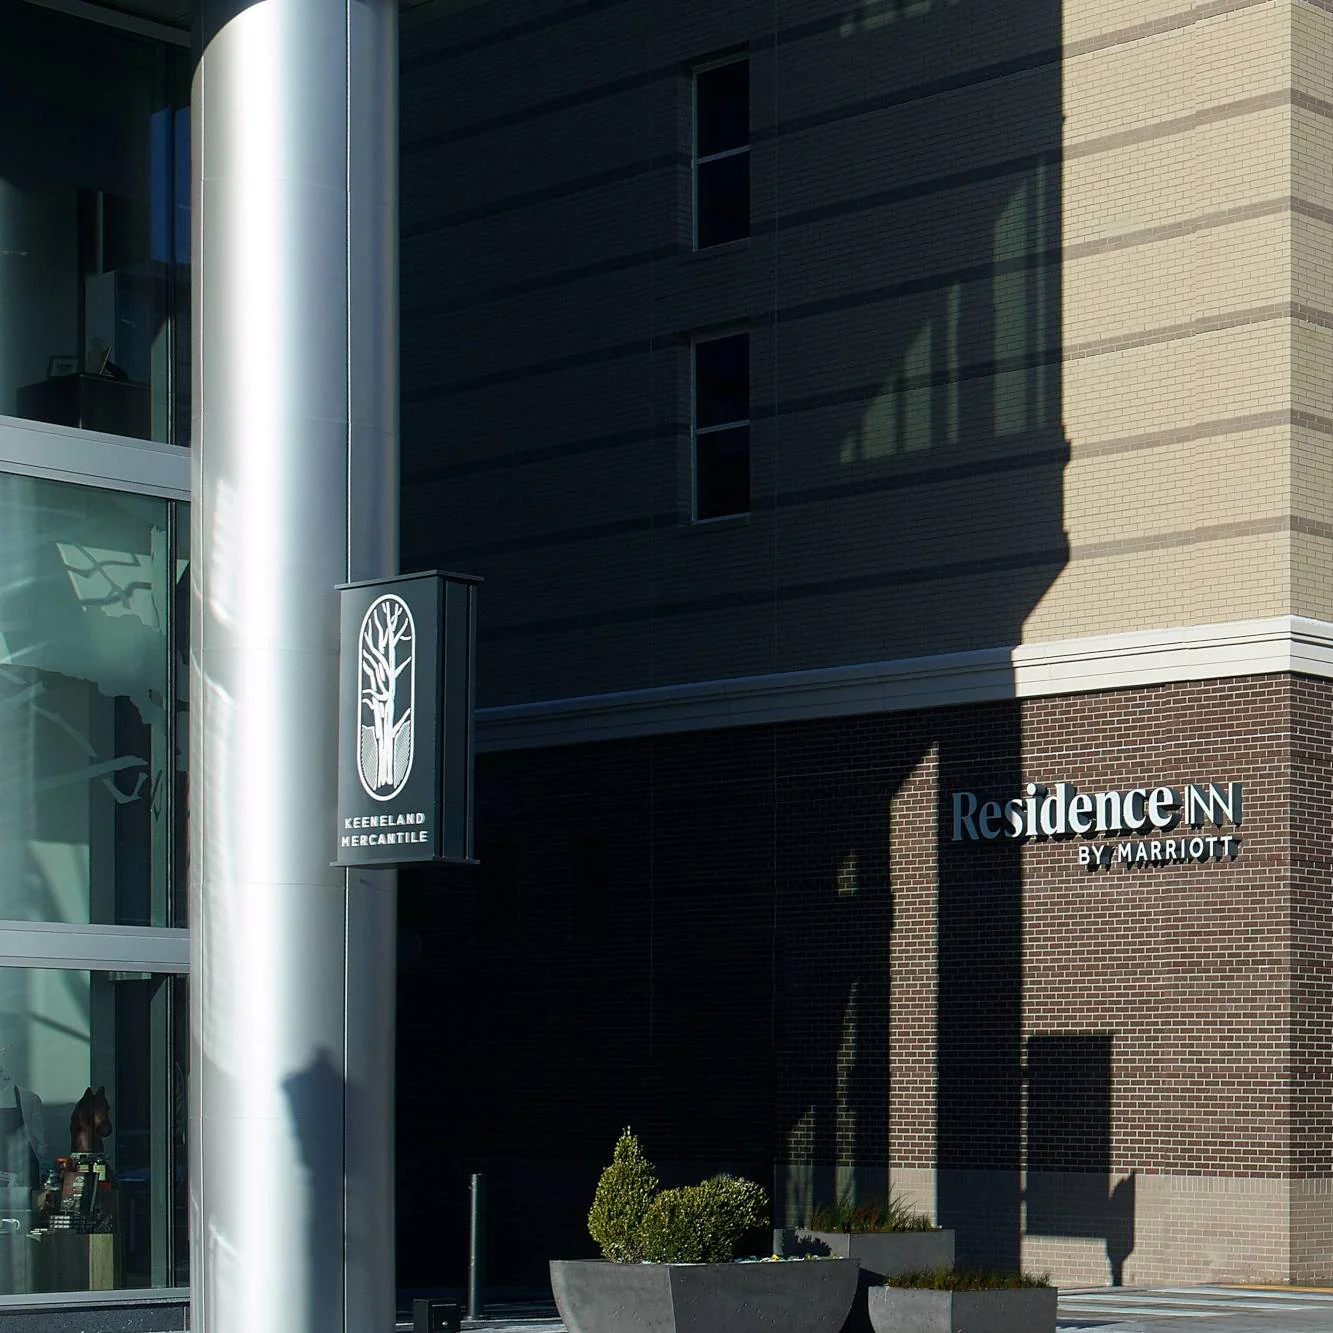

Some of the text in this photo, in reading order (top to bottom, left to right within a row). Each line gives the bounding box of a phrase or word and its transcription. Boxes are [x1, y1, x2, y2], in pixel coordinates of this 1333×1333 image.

[344, 812, 426, 829] KEENELAND
[951, 782, 1233, 842] Residence INN
[341, 830, 429, 847] MERCANTILE
[1078, 835, 1234, 865] BY MARRIOTT
